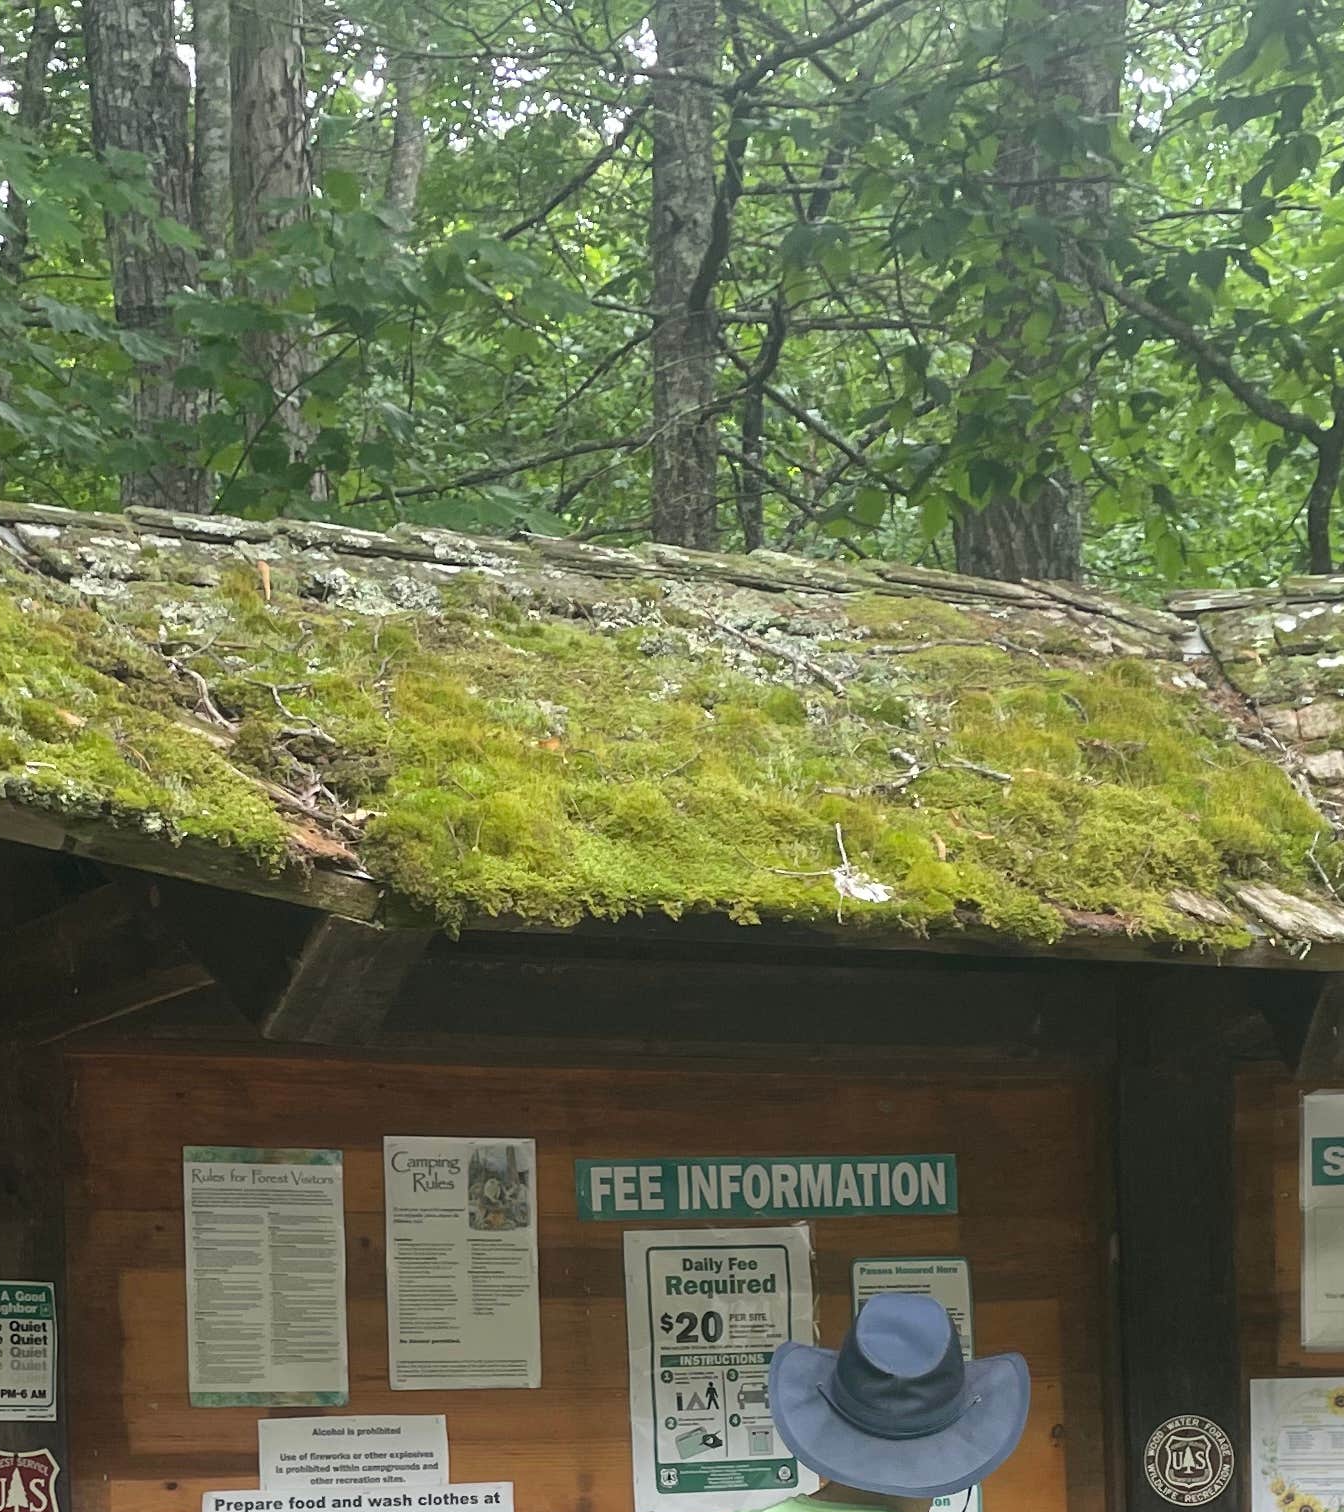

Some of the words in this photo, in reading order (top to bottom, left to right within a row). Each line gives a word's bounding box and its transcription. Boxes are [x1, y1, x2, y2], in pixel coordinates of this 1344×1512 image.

[391, 1150, 461, 1174] Camping
[191, 1168, 225, 1184] Rules
[230, 1168, 248, 1183] for
[251, 1169, 288, 1184] Forest
[292, 1171, 334, 1186] Visitors
[412, 1172, 455, 1193] Rules
[589, 1166, 664, 1212] FEE
[677, 1162, 947, 1210] INFORMATION
[681, 1257, 722, 1274] Daily
[728, 1258, 758, 1271] Fee
[665, 1274, 776, 1300] Required
[0, 1291, 10, 1301] A
[15, 1291, 46, 1302] Good
[9, 1320, 47, 1333] Quiet
[660, 1311, 723, 1343] $20
[10, 1333, 48, 1346] Quiet
[680, 1353, 765, 1366] INSTRUCTIONS
[0, 1389, 27, 1399] PM-6
[30, 1389, 47, 1399] AM
[311, 1427, 345, 1437] Alcohol
[347, 1427, 355, 1436] is
[356, 1426, 401, 1437] prohibited
[1167, 1418, 1199, 1430] WATER
[1148, 1431, 1164, 1456] WOOD
[1204, 1423, 1232, 1456] FORAGE
[280, 1453, 296, 1462] Use
[299, 1452, 308, 1461] of
[309, 1451, 351, 1461] fireworks
[364, 1450, 387, 1460] other
[389, 1450, 434, 1461] explosives
[275, 1464, 283, 1474] is
[285, 1464, 330, 1475] prohibited
[332, 1464, 359, 1473] within
[362, 1462, 420, 1474] campgrounds
[422, 1461, 439, 1471] and
[310, 1477, 333, 1486] other
[335, 1475, 381, 1485] recreation
[382, 1474, 406, 1484] sites.
[1147, 1464, 1178, 1500] WILDLIFE
[1184, 1464, 1231, 1502] RECREATION
[214, 1497, 284, 1512] Prepare
[288, 1495, 326, 1510] food
[331, 1494, 362, 1509] and
[367, 1493, 412, 1507] wash
[417, 1492, 479, 1507] clothes
[484, 1492, 501, 1505] at
